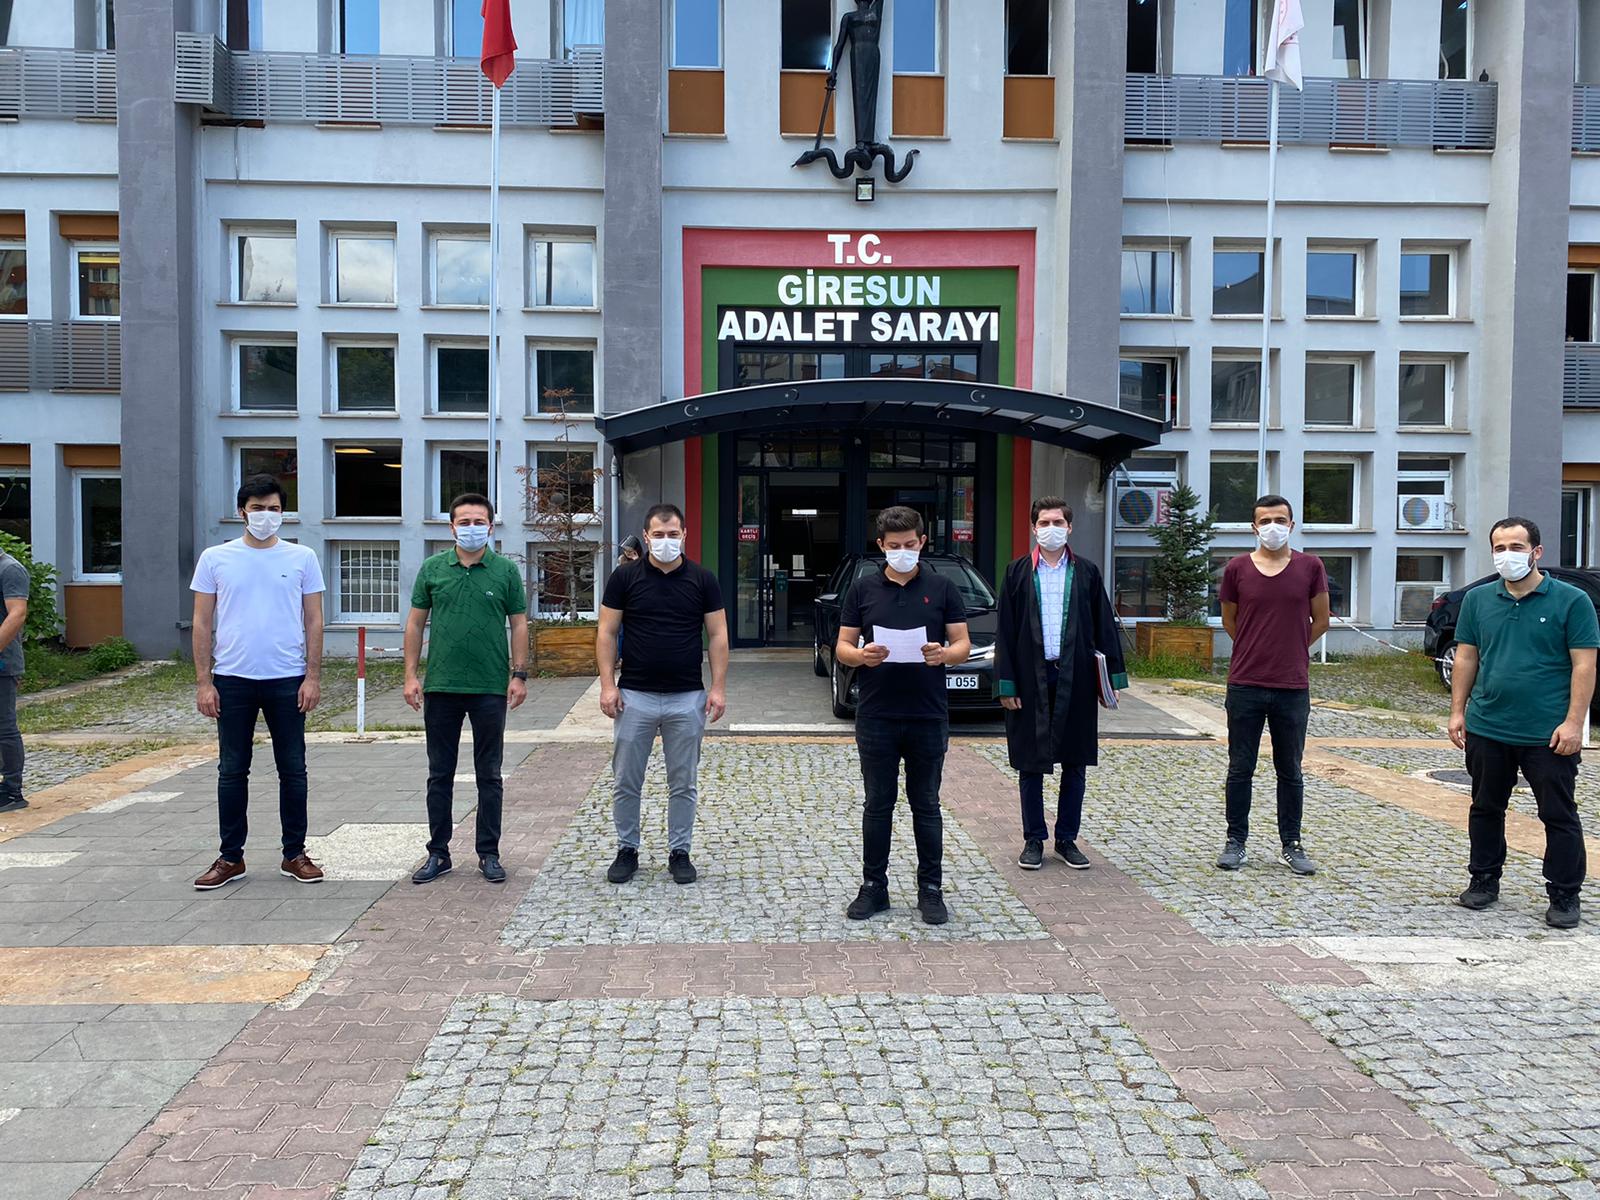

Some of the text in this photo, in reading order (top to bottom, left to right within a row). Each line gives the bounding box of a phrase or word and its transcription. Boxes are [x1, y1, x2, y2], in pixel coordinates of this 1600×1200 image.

[827, 233, 892, 264] T.C.
[777, 268, 941, 306] GİRESUN
[717, 310, 999, 342] ADALET SARAYI
[957, 677, 976, 687] 055
